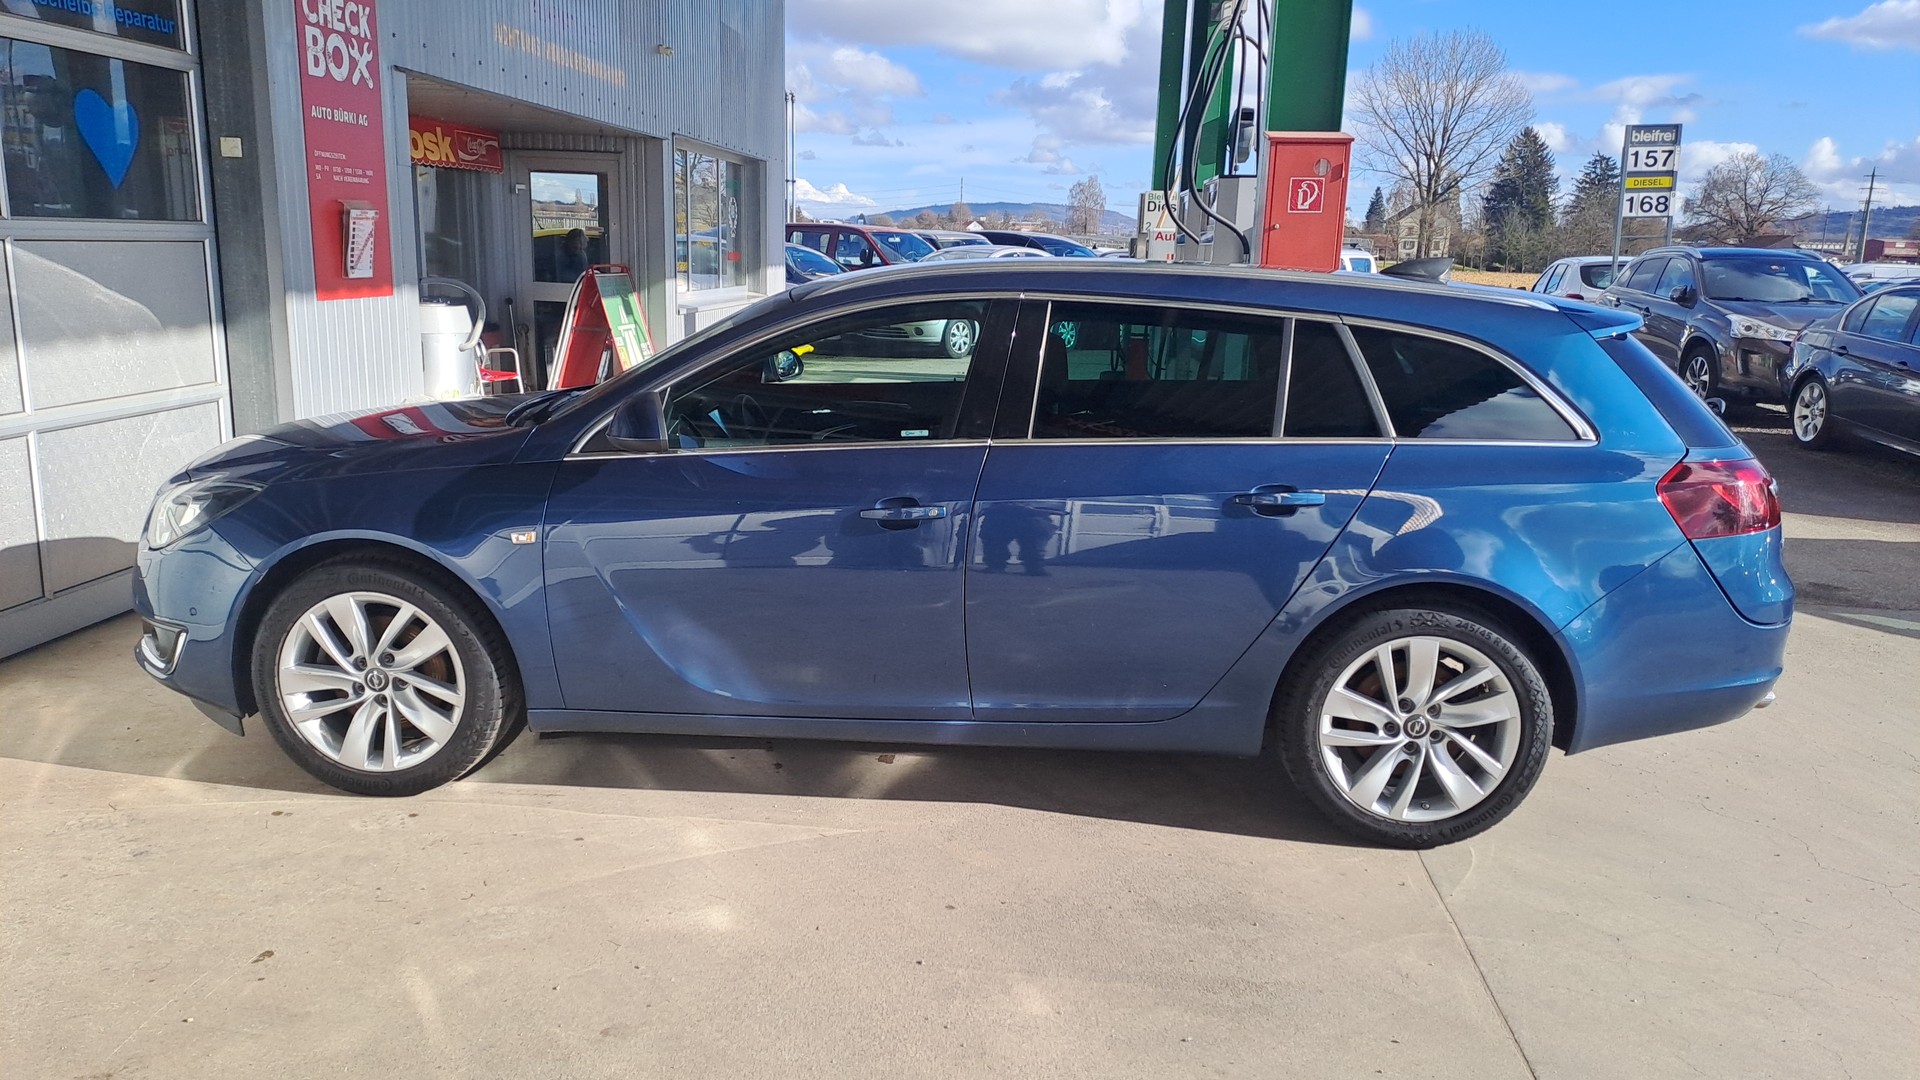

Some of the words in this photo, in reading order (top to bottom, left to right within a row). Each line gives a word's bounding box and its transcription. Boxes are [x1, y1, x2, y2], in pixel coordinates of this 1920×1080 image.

[302, 0, 372, 40] CHECK
[305, 25, 374, 89] BOX
[311, 105, 332, 120] AUTO
[334, 108, 357, 124] BÜRKI
[358, 114, 368, 126] AG
[1631, 130, 1676, 142] bleifrei
[1630, 150, 1674, 168] 157
[1633, 179, 1663, 187] DIESEL
[1625, 195, 1669, 214] 168
